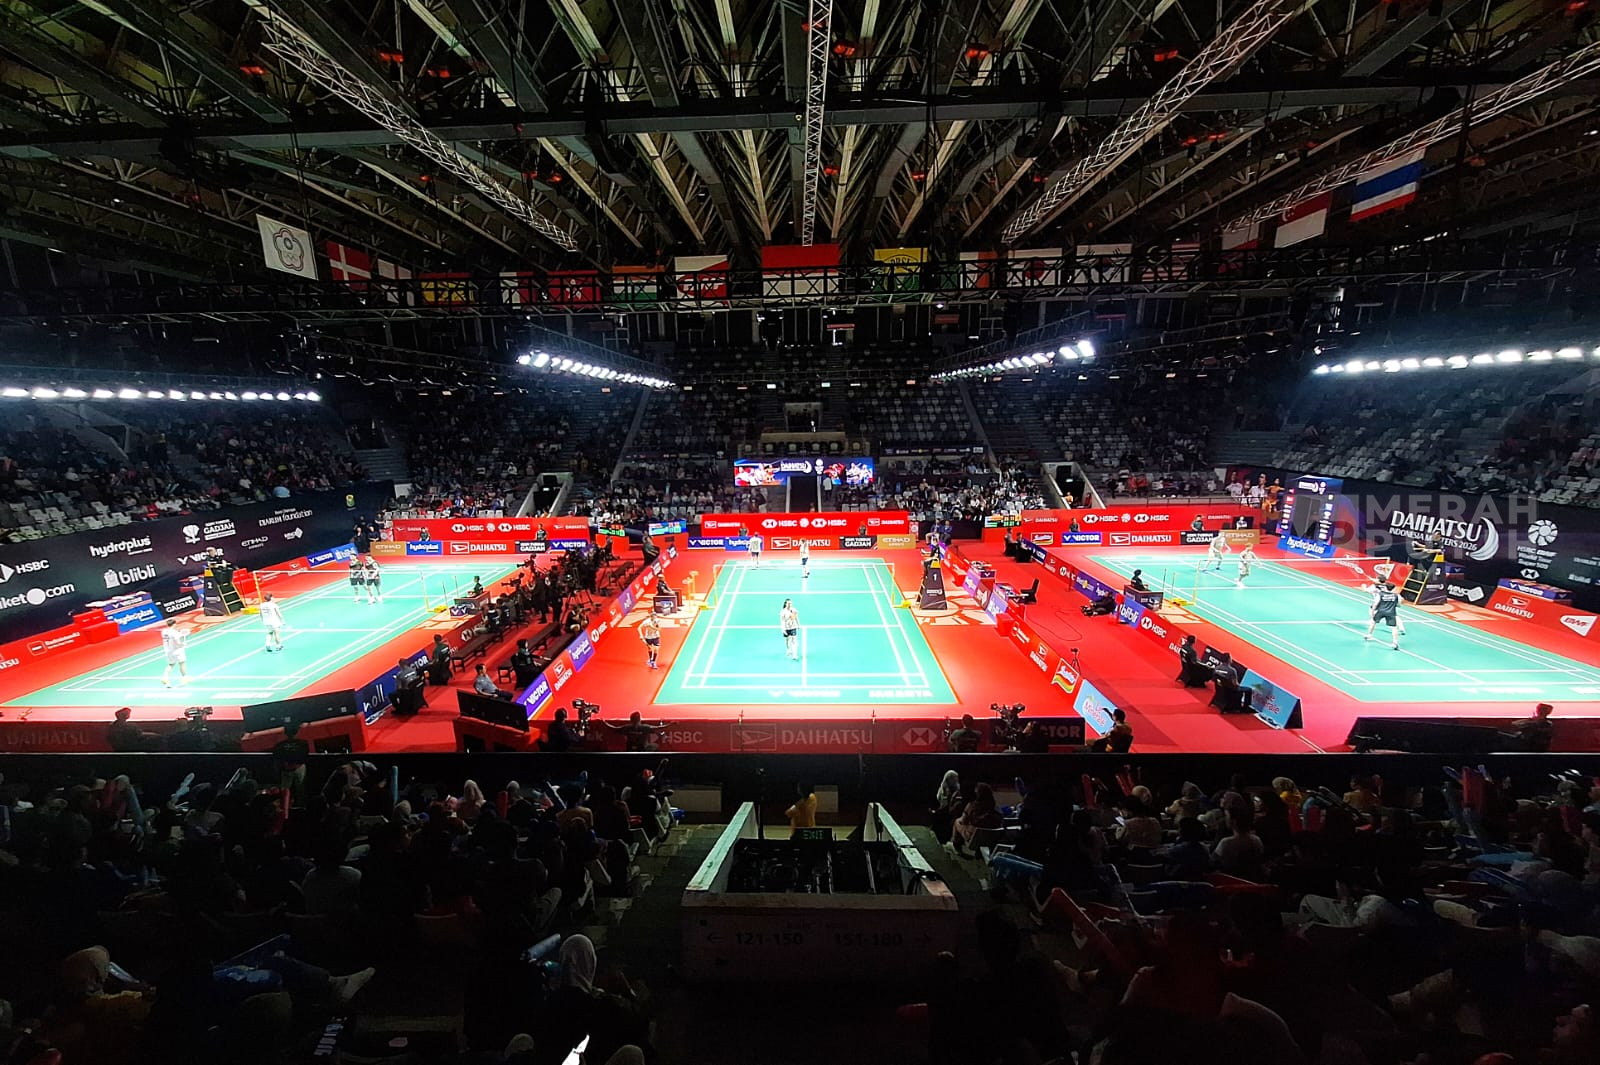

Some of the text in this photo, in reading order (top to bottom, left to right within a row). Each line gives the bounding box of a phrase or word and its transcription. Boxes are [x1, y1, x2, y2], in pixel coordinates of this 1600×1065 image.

[282, 510, 313, 521] foundation
[203, 522, 235, 534] GADJAH
[1390, 510, 1482, 542] DAIHATSU
[90, 535, 152, 557] hydroplus
[241, 536, 269, 546] ETIHAD
[792, 539, 830, 547] DAHATSU
[1131, 534, 1171, 543] DAIHATSU
[1287, 537, 1325, 553] hydroplus
[1389, 527, 1478, 551] INDONESIA MTERS 2026
[470, 543, 507, 551] DAIHATSU
[15, 559, 50, 574] HSBC
[118, 564, 156, 584] blibli
[166, 599, 196, 612] GADJAH
[1494, 603, 1534, 619] DAIHATSU
[1151, 623, 1167, 638] HSBC
[410, 655, 429, 670] CTOR
[526, 680, 549, 705] VICTOR
[662, 730, 703, 744] HSBC
[782, 729, 873, 745] DAIHATSU
[801, 829, 824, 840] EXIT
[735, 932, 903, 945] 121-150 151-180
